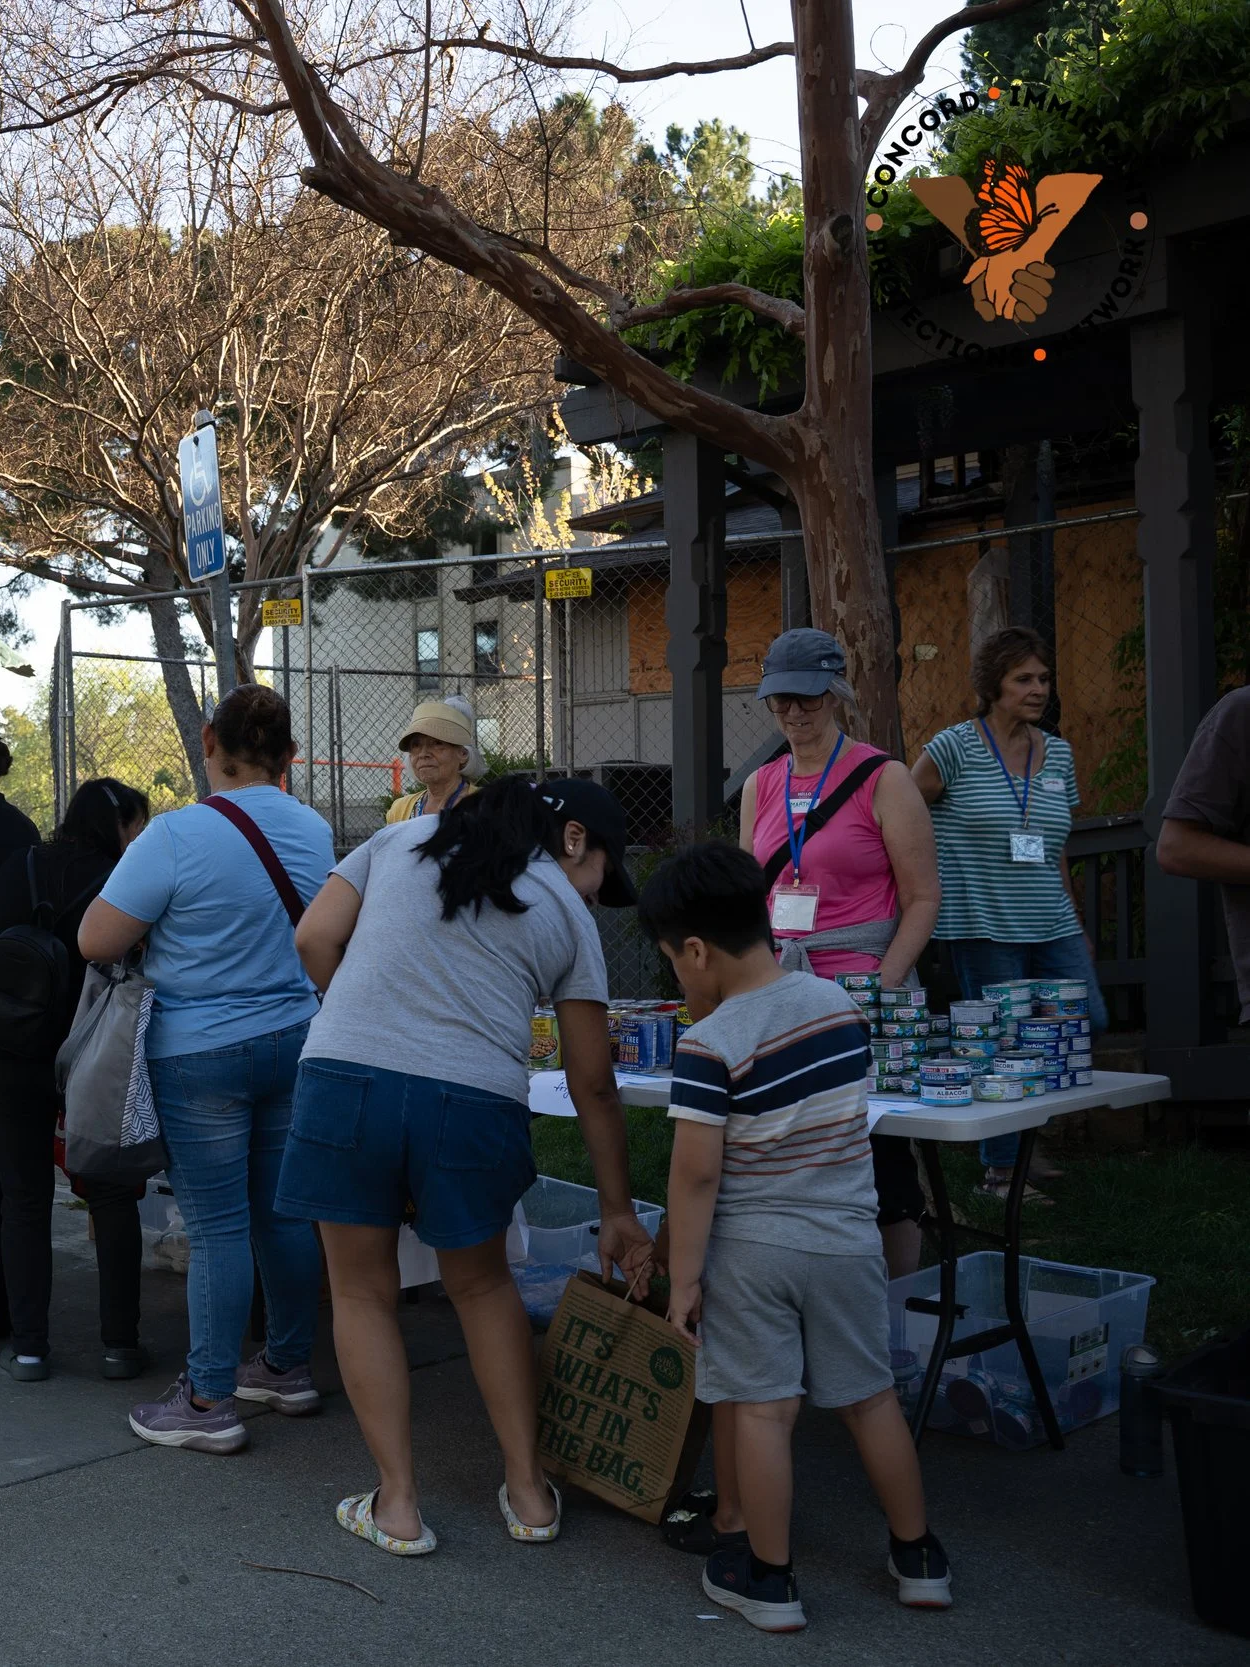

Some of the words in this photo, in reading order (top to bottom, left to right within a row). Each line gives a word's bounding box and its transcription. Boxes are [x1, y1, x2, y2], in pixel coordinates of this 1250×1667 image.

[186, 502, 220, 539] PARKING
[196, 538, 215, 568] ONLY
[548, 578, 588, 588] SECURITY
[265, 608, 299, 616] SECURITY
[560, 1313, 616, 1361] IT'S
[553, 1348, 662, 1422] WHAT'S
[541, 1382, 598, 1431] NOT
[596, 1408, 633, 1446] IN
[538, 1415, 584, 1464] THE
[585, 1441, 646, 1497] BAG.
